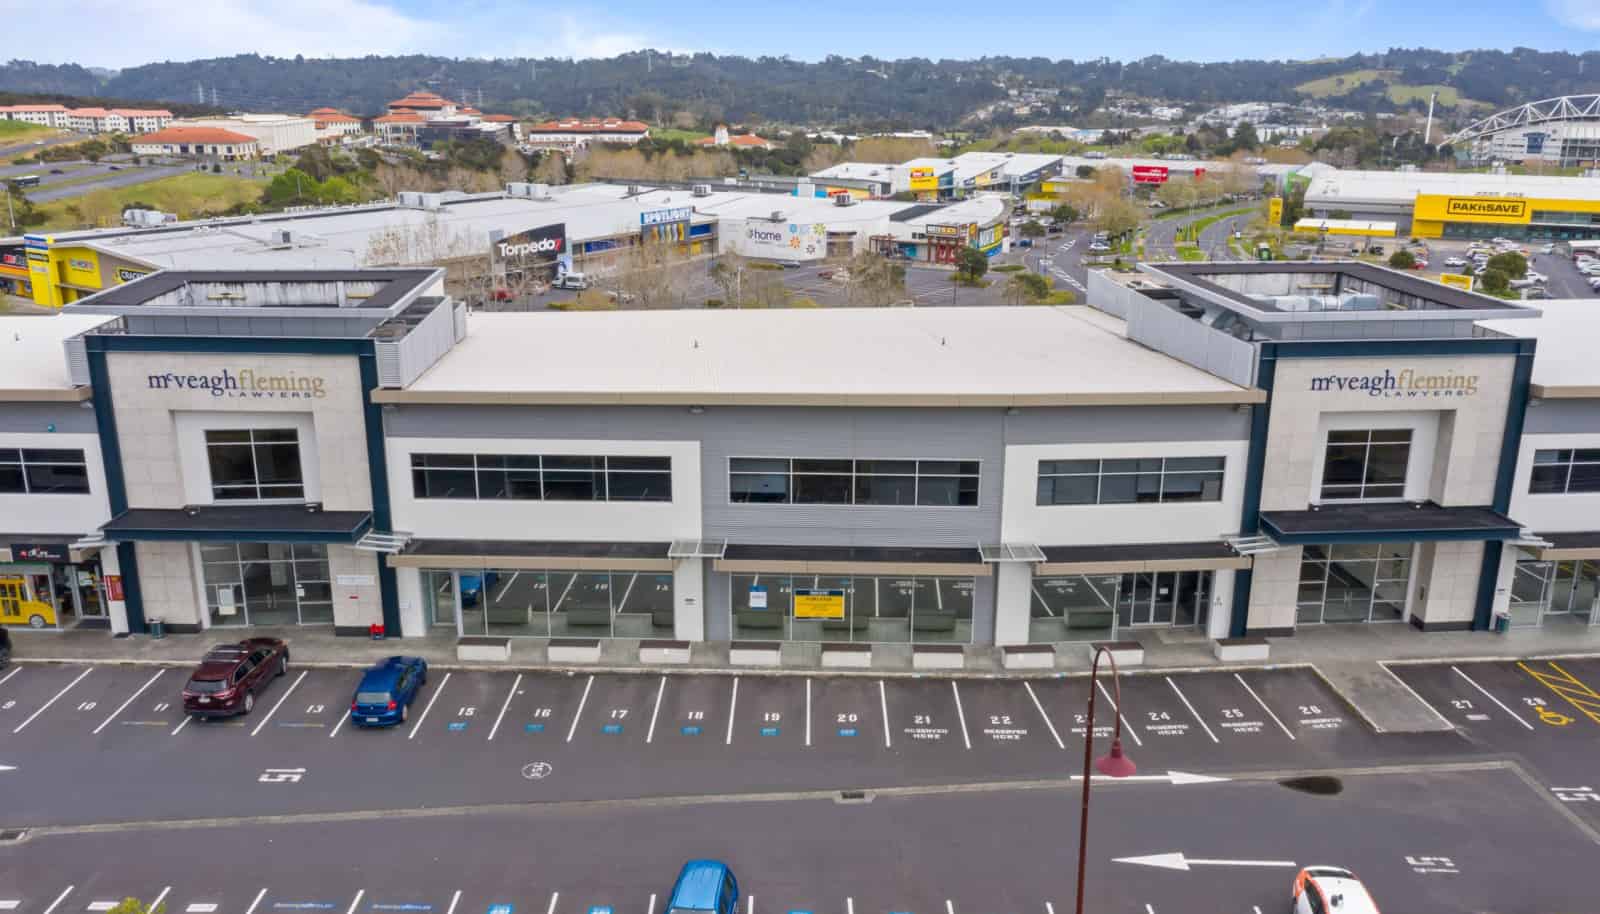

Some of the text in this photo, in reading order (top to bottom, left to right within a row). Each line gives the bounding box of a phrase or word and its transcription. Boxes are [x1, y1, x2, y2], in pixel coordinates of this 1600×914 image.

[77, 701, 97, 711] 10
[153, 703, 169, 712] 11
[306, 704, 325, 713] 13
[1451, 699, 1473, 709] 27
[457, 707, 476, 716] 15
[534, 708, 552, 717] 16
[611, 709, 629, 719] 17
[687, 711, 704, 720] 18
[1148, 711, 1171, 721] 24
[764, 712, 781, 722] 19
[837, 713, 858, 723] 20
[914, 715, 931, 725] 21
[990, 715, 1012, 725] 22
